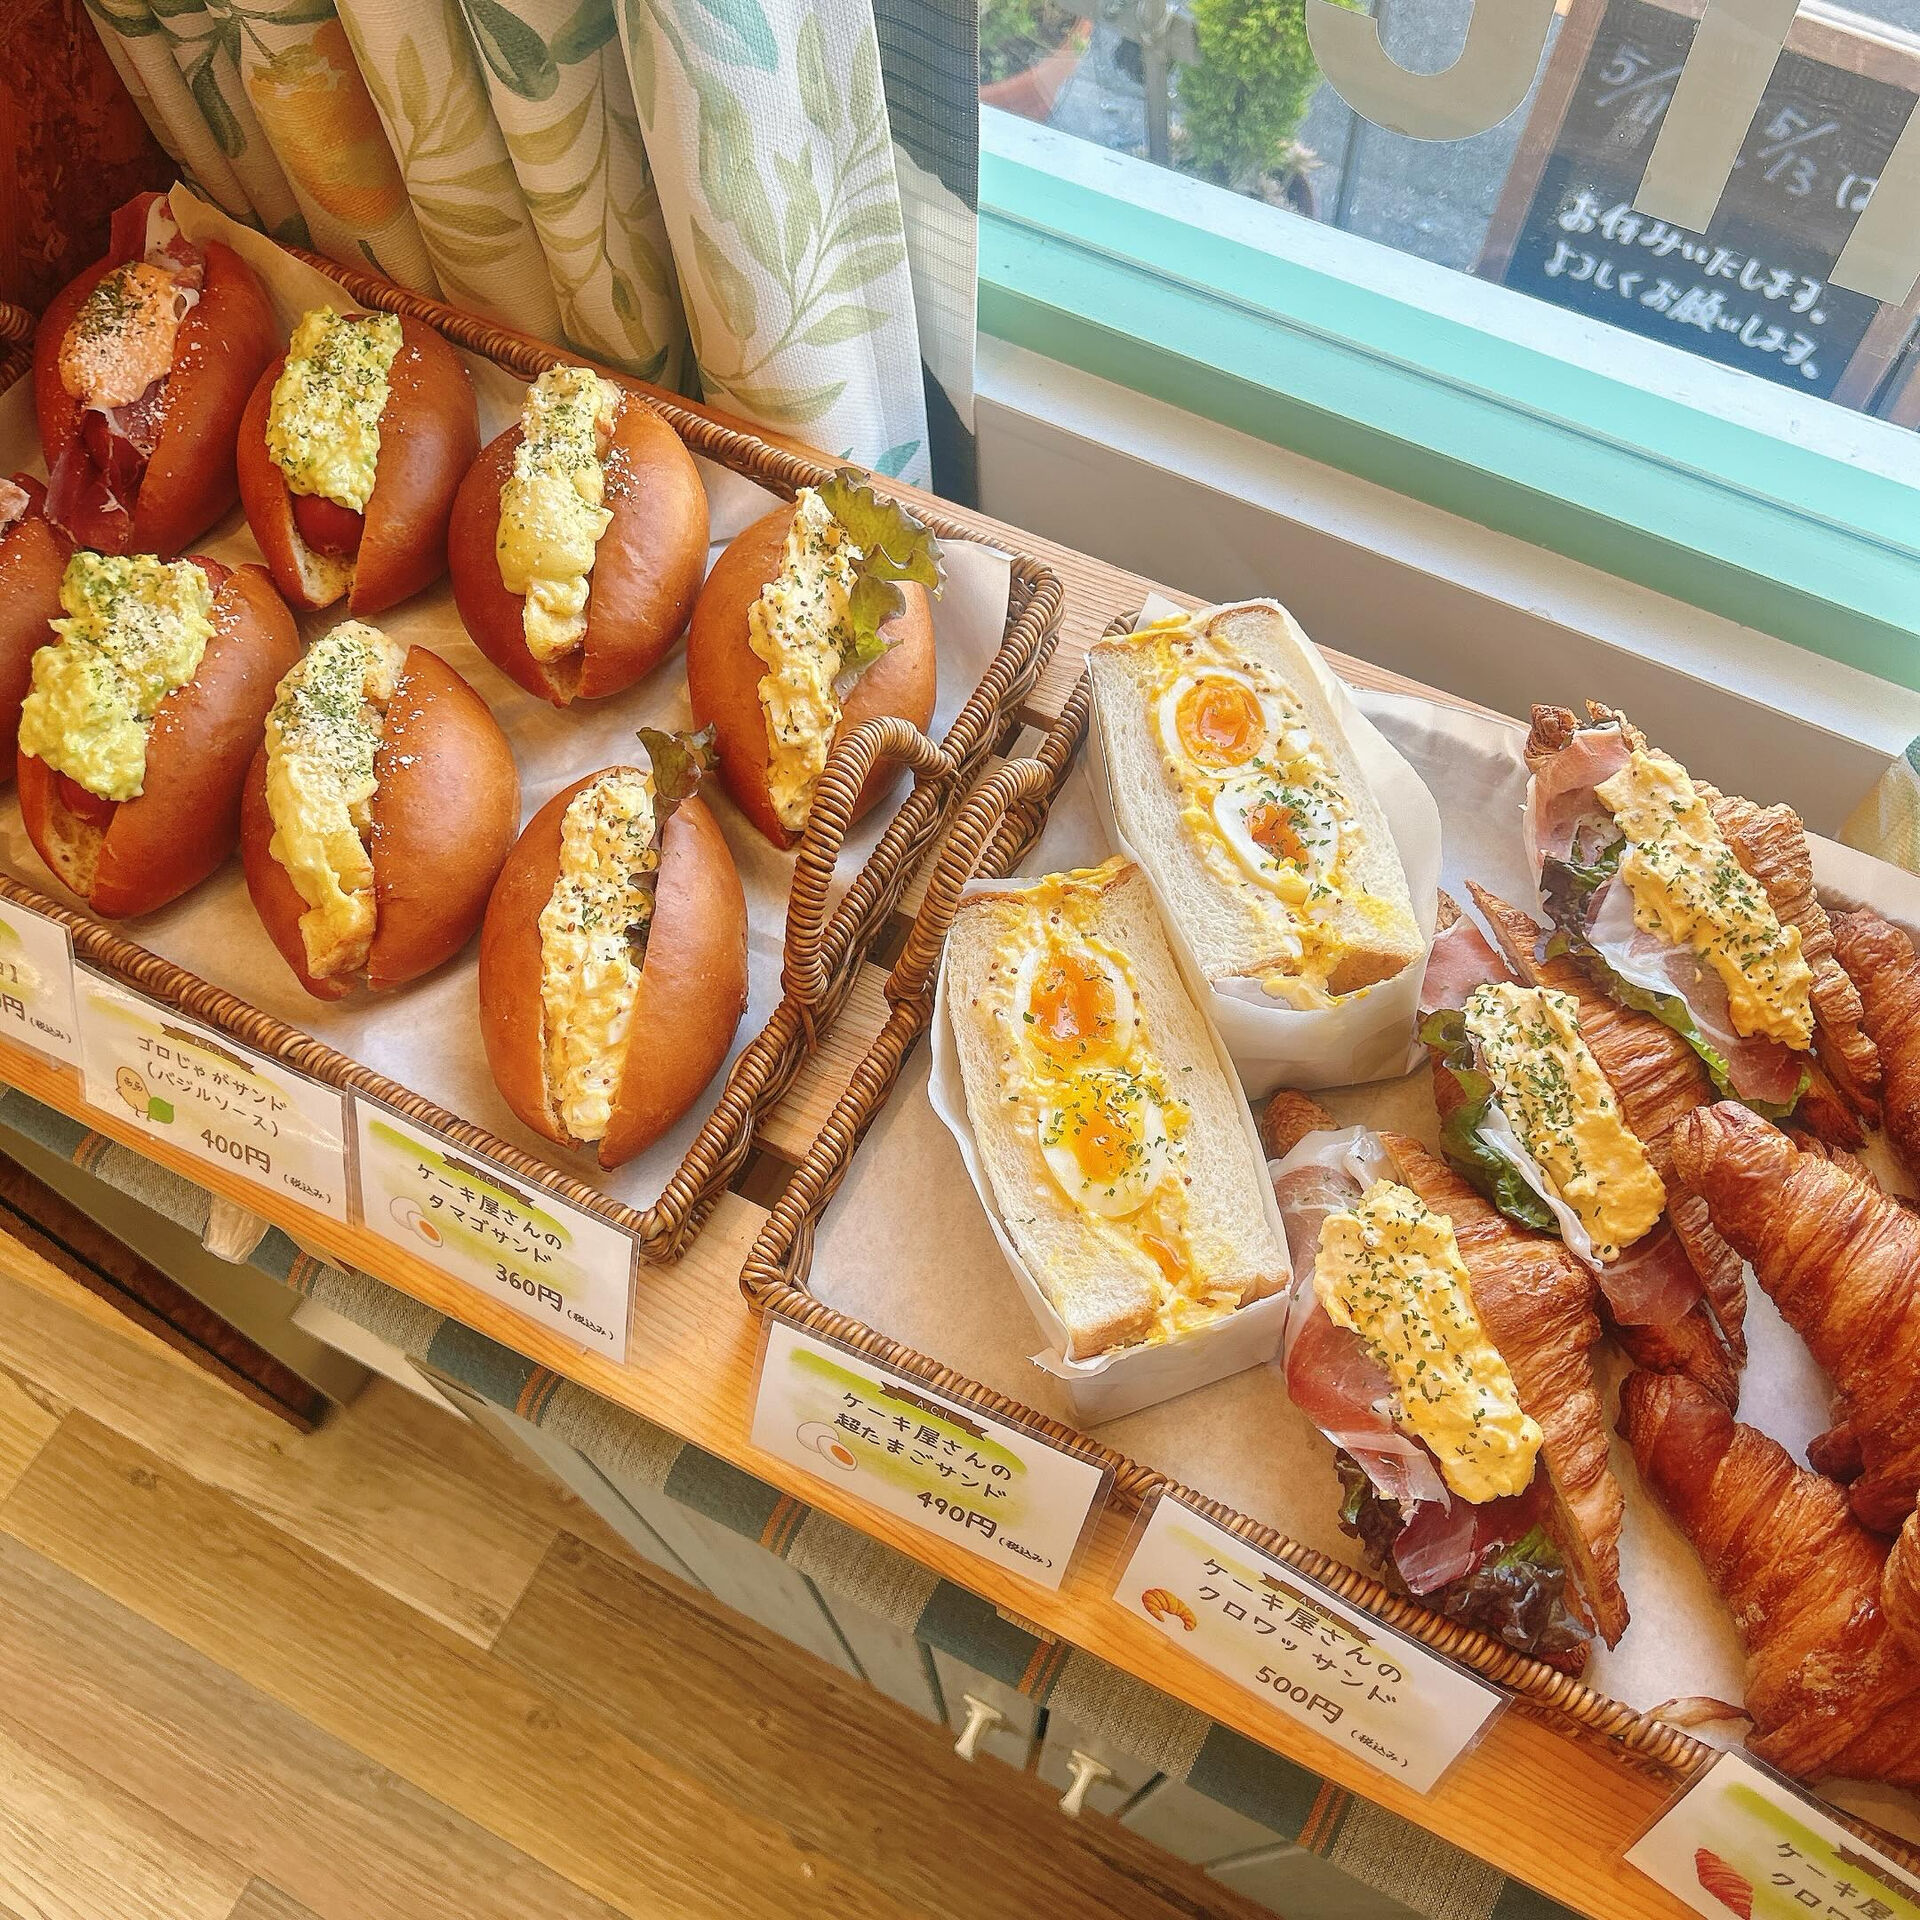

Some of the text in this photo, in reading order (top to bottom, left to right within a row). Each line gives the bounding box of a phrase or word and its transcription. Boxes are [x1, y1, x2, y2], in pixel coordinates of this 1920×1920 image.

[137, 1036, 287, 1111] ゴロじゃがサンド
[148, 1061, 279, 1138] (バジルソース)
[200, 1128, 271, 1174] 400円
[417, 1163, 562, 1250] ケーキ屋さんの
[429, 1194, 552, 1264] タマゴサンド
[495, 1263, 563, 1312] 360円
[834, 1412, 1006, 1499] 超たまごサンド
[843, 1392, 1011, 1480] ケーキ屋さんの
[917, 1491, 1053, 1568] 490円 (税込み)
[1199, 1586, 1397, 1704] クロワッサンド
[1204, 1558, 1402, 1683] ケーキ屋さんの
[1255, 1665, 1409, 1768] 500円 (税込み)
